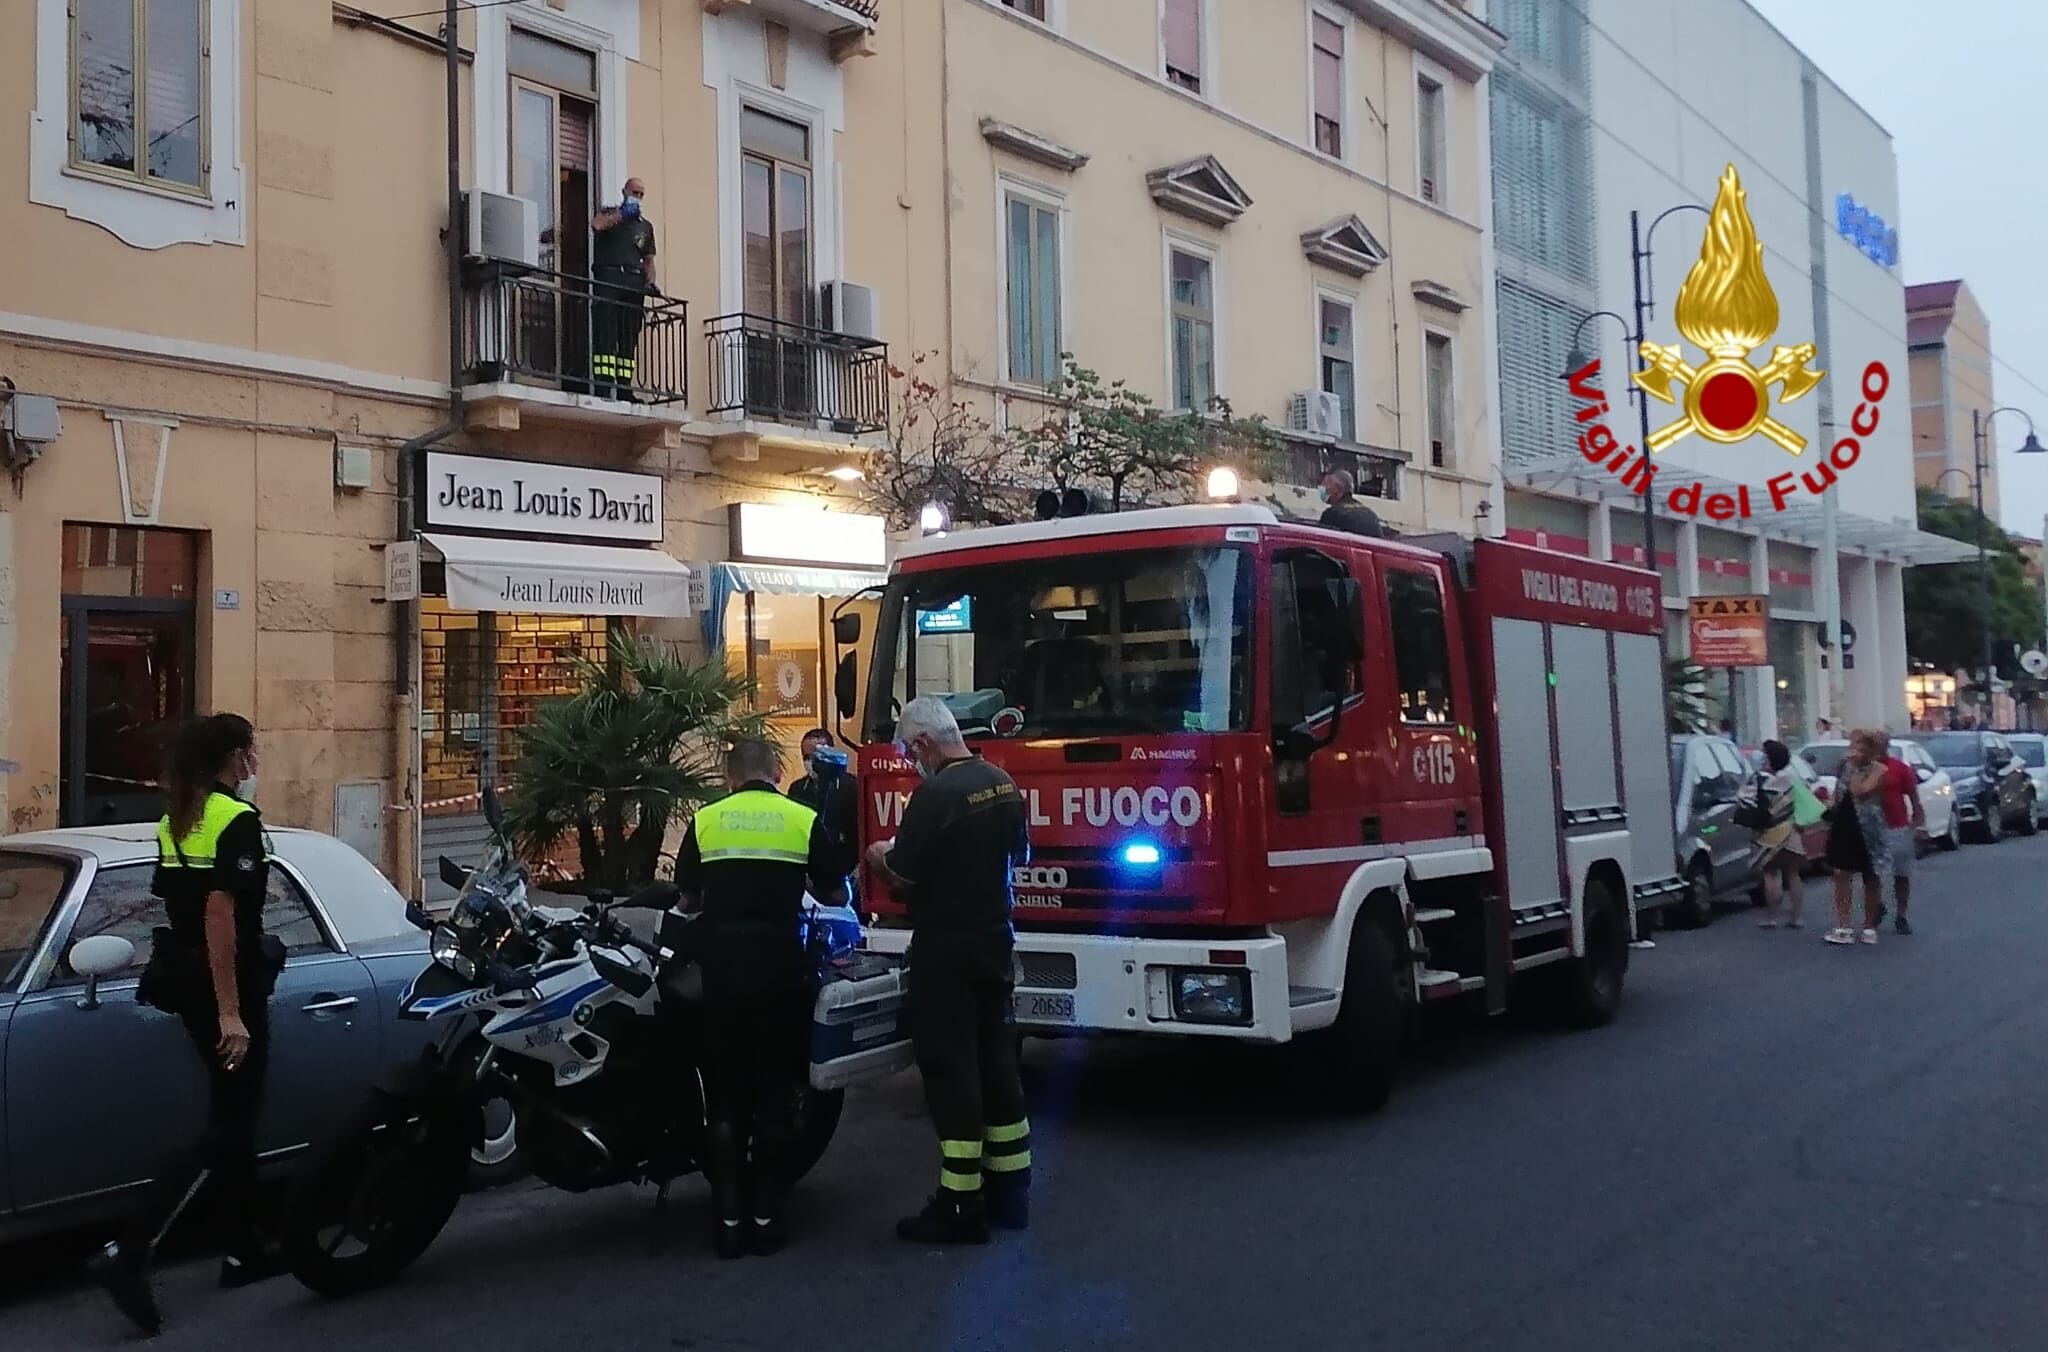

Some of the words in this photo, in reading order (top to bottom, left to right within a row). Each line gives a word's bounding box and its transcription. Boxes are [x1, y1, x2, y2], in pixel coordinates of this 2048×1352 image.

[438, 473, 503, 511] Jean
[513, 480, 582, 518] Louis
[588, 487, 655, 524] David
[500, 575, 543, 603] Jean
[549, 578, 594, 604] Louis
[599, 579, 644, 606] David
[754, 570, 793, 587] GELATO
[224, 591, 231, 601] 7
[1559, 574, 1582, 607] DEL
[1582, 579, 1619, 613] FUOCO
[1694, 600, 1762, 614] TAXI
[719, 810, 785, 821] POLIZIA
[1062, 785, 1202, 828] FUOCO
